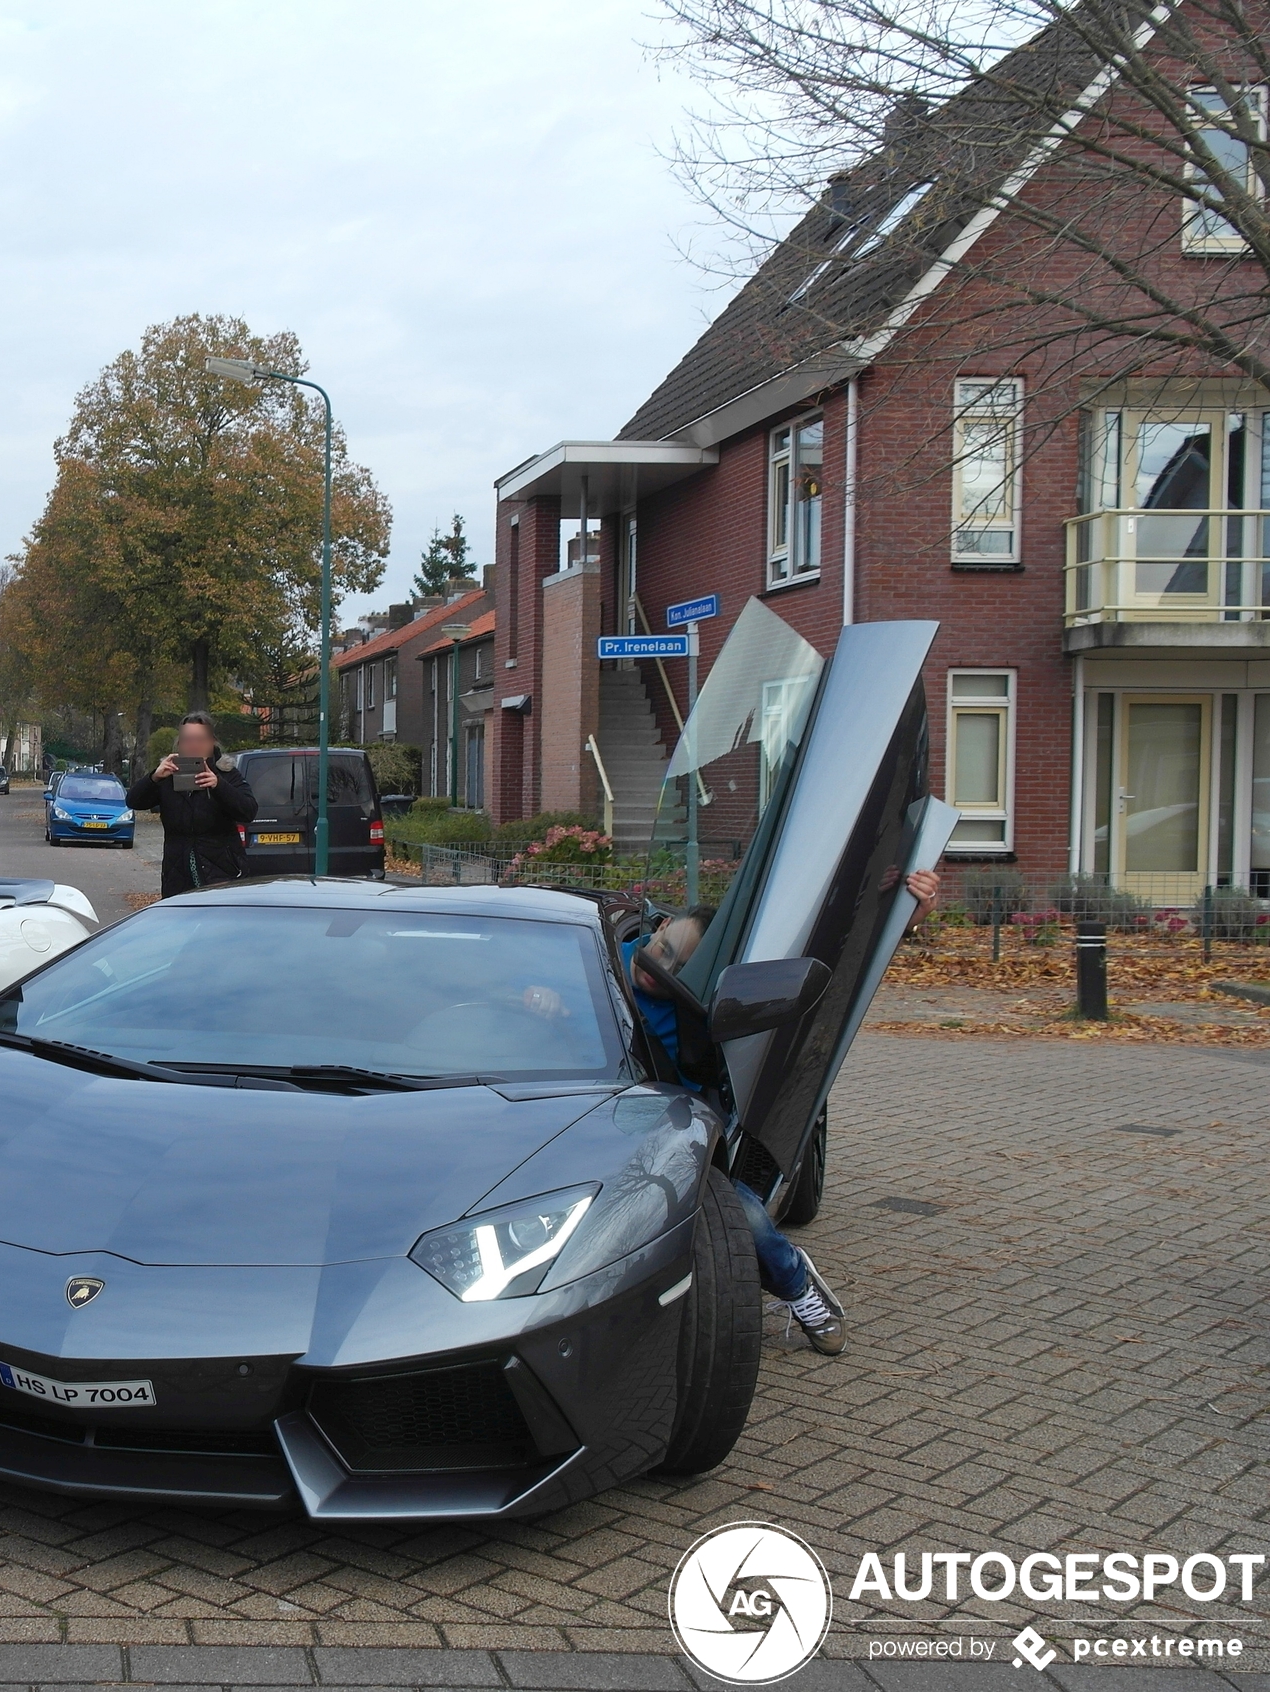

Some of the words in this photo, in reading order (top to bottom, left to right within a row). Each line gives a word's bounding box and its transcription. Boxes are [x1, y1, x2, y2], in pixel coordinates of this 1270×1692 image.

[671, 609, 682, 621] Kon.
[683, 603, 712, 619] Julianalaan
[605, 642, 622, 652] Pr.
[625, 641, 681, 652] Irenelaan
[259, 833, 296, 842] 9-VHF-57
[16, 1374, 46, 1395] HS
[51, 1385, 79, 1402] LP
[85, 1387, 150, 1403] 7004
